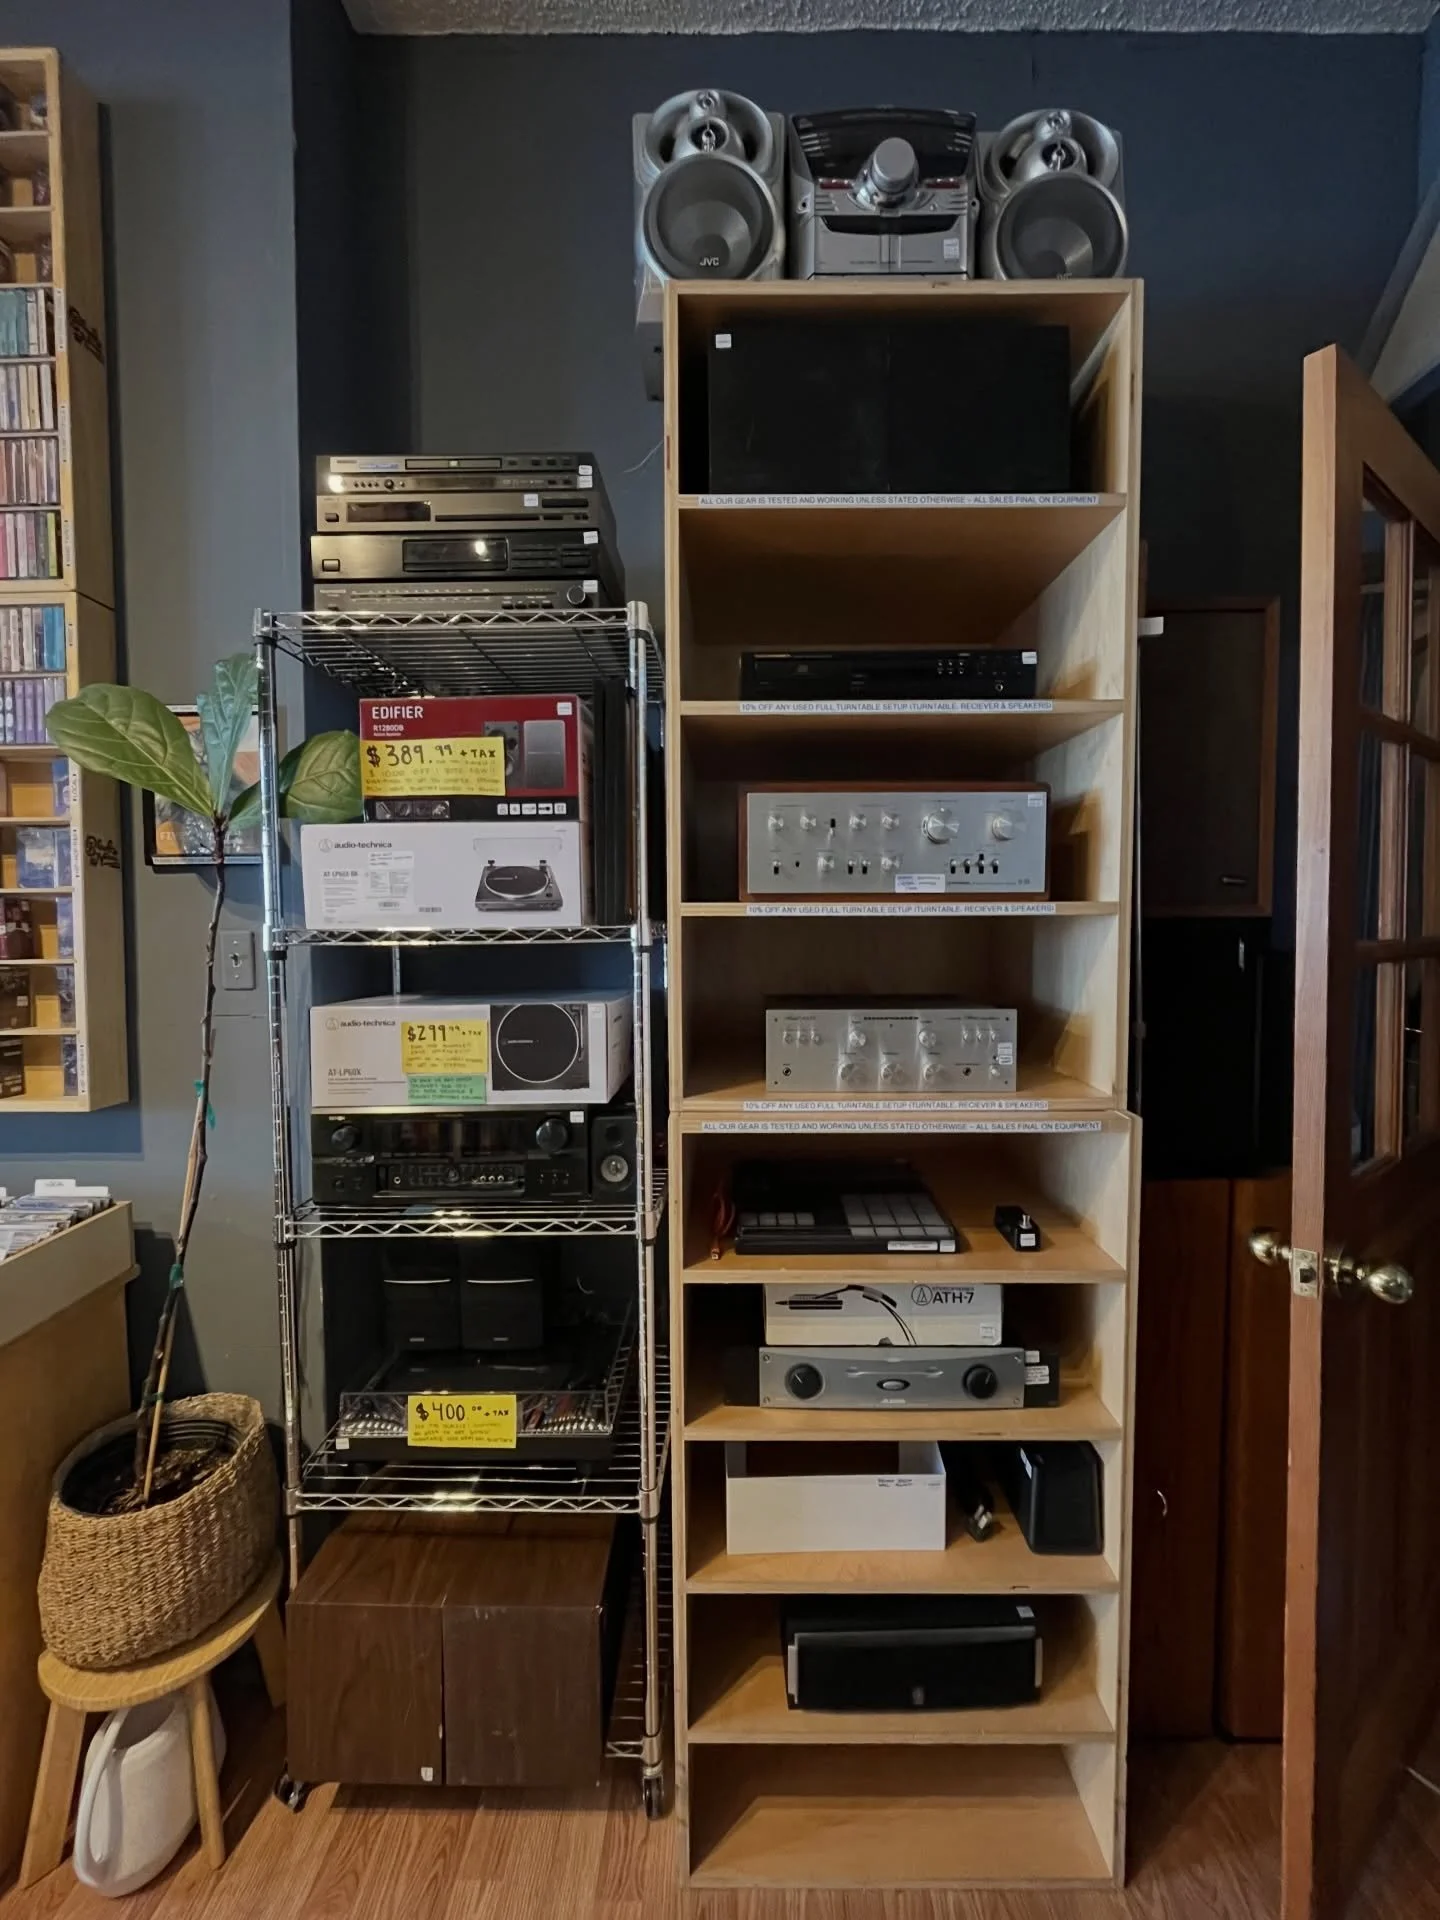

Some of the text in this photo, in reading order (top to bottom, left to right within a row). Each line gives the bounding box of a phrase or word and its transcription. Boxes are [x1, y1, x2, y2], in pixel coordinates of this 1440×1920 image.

[700, 256, 720, 266] JVC
[816, 496, 854, 504] WORKING
[856, 496, 886, 504] UNLESS
[888, 496, 918, 504] STATED
[920, 496, 966, 504] OTHERWISE
[973, 496, 987, 504] ALL
[988, 496, 1014, 504] SALES
[1016, 496, 1036, 504] FINAL
[1038, 496, 1050, 504] ON
[1052, 496, 1096, 504] EQUIPMENT
[371, 706, 424, 720] EDIFIER
[471, 749, 496, 759] TAX
[334, 840, 393, 850] audio-technica
[340, 1019, 396, 1028] audio-technica
[858, 1122, 888, 1130] UNLESS
[890, 1122, 920, 1130] STATED
[922, 1122, 966, 1130] OTHERWISE
